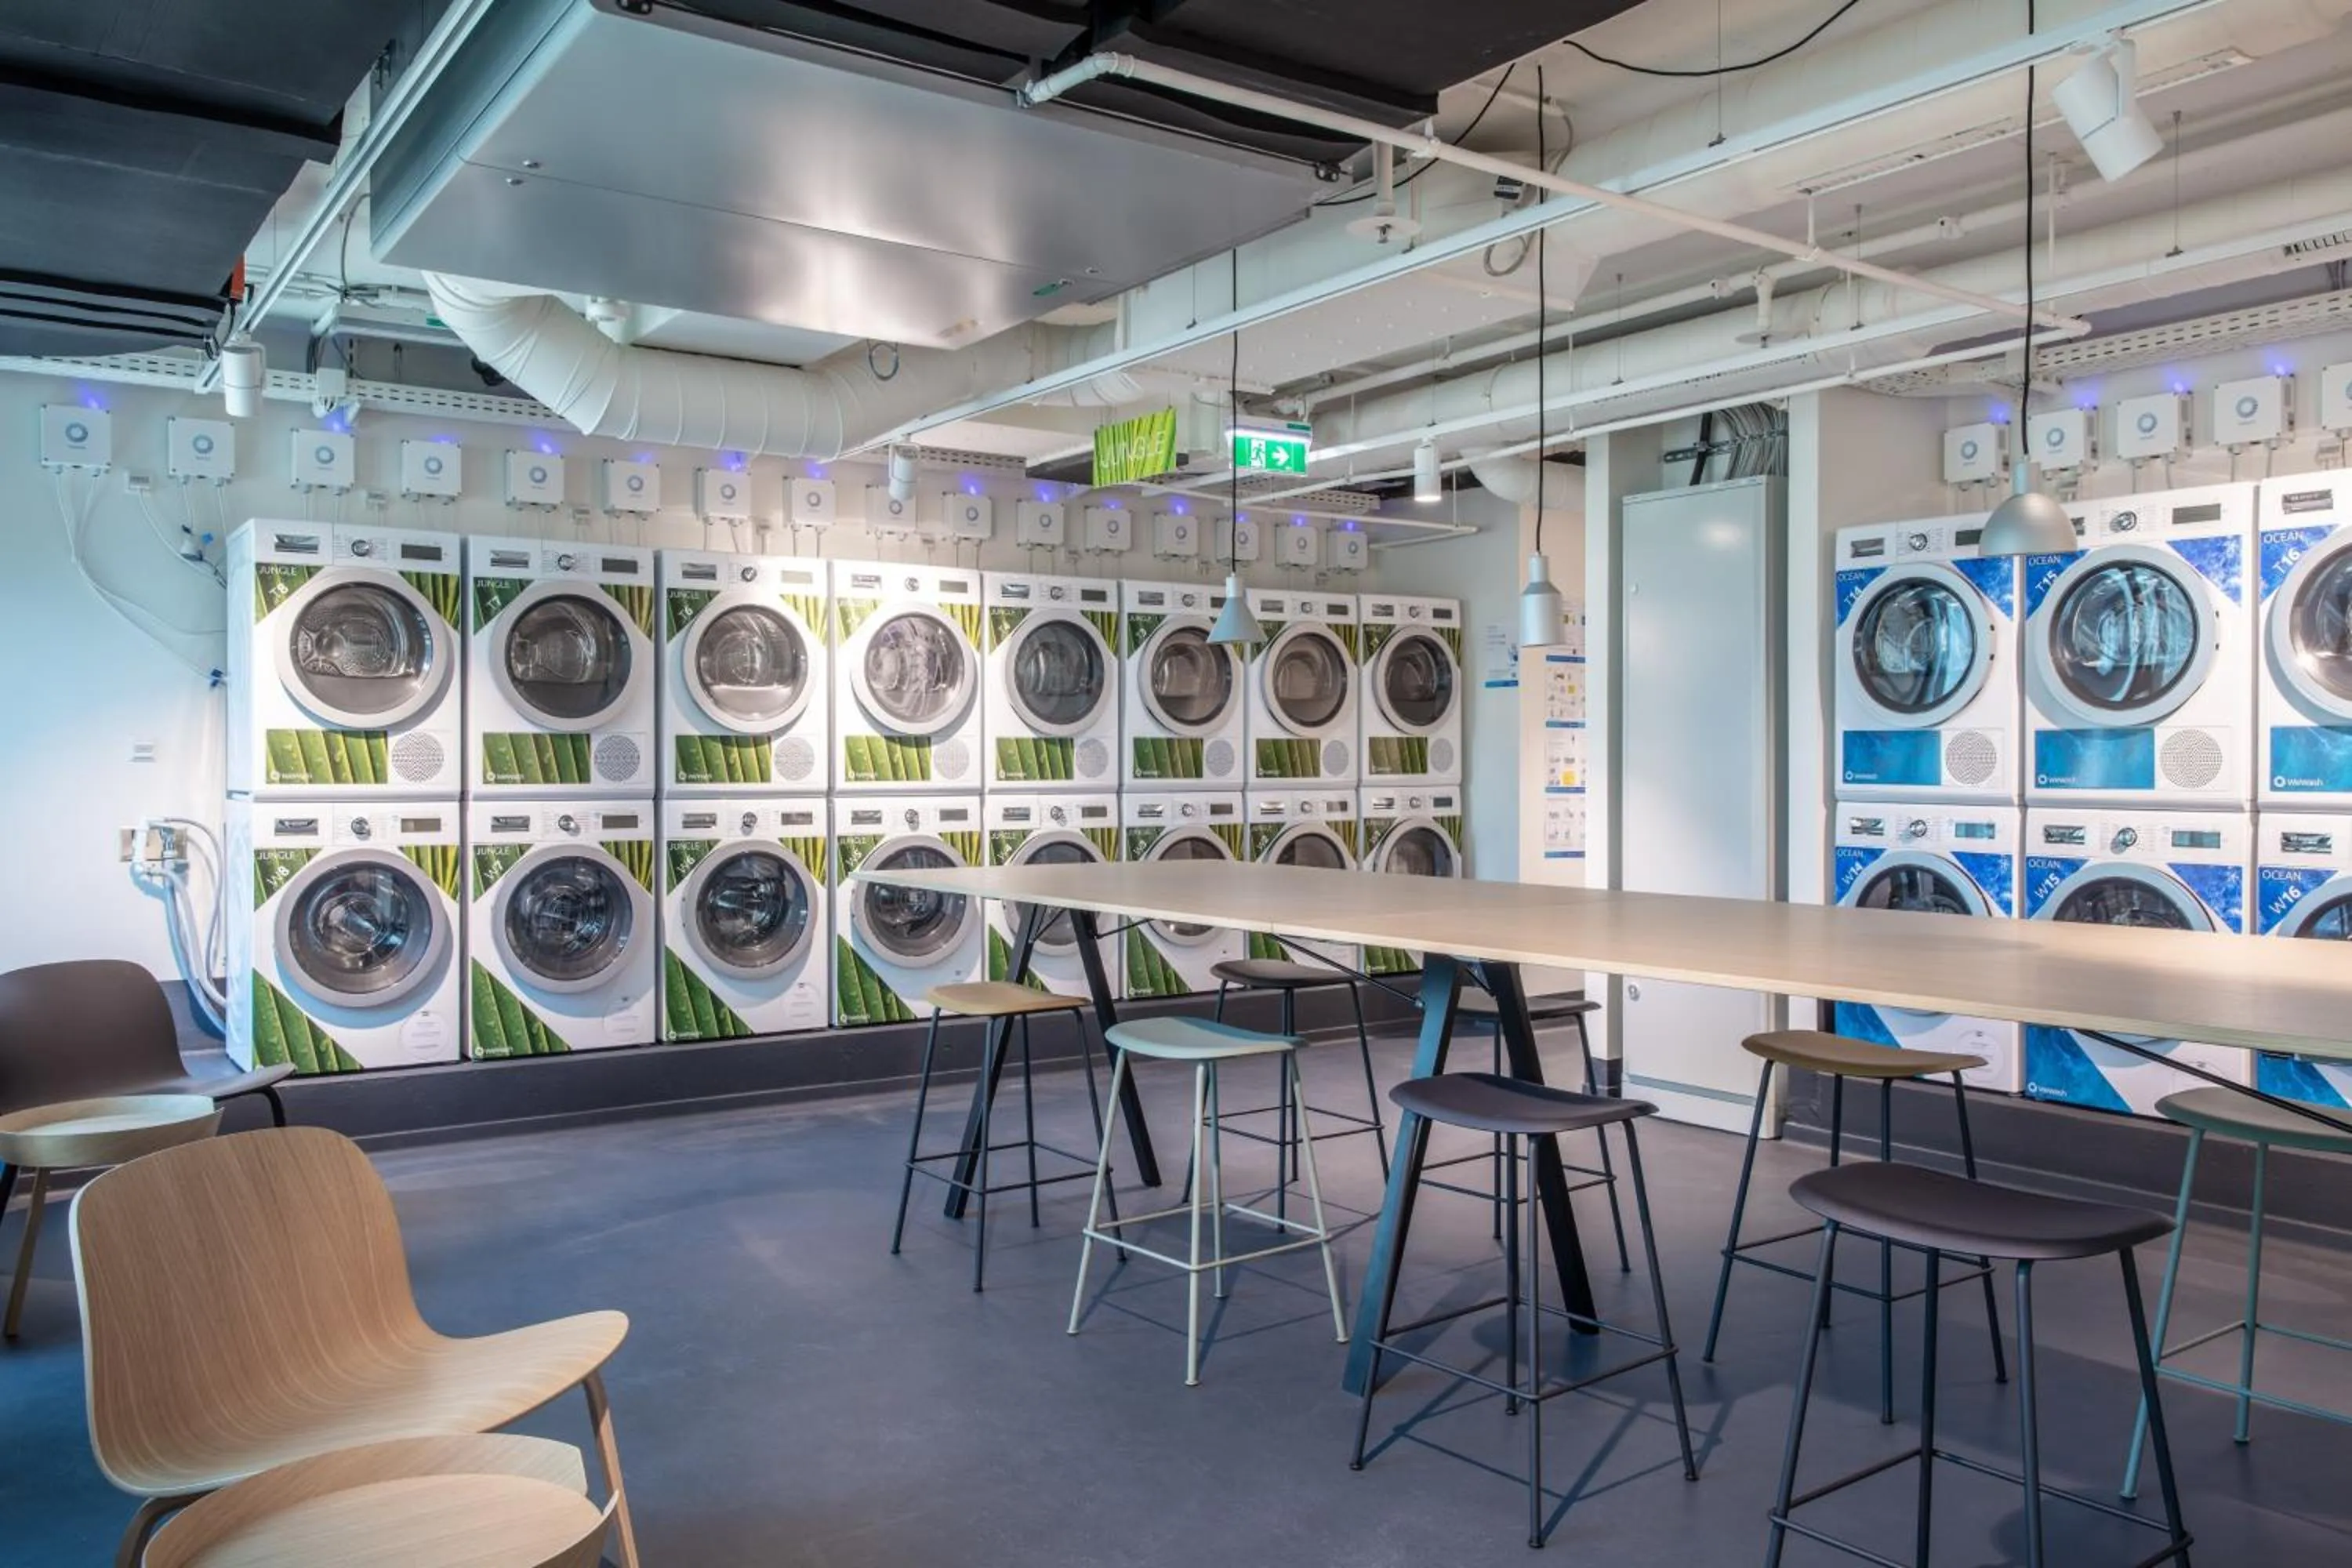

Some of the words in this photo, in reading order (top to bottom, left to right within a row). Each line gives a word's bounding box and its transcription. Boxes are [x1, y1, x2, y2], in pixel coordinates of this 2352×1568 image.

[1100, 430, 1166, 468] JUNGLE
[2263, 531, 2303, 544] OCEAN
[2028, 554, 2061, 566] OCEAN
[2272, 547, 2301, 574] T16
[258, 565, 297, 576] JUNGLE
[1837, 572, 1866, 582] OCEAN
[2034, 570, 2058, 593] T15
[268, 583, 289, 598] T8
[256, 851, 295, 860] JUNGLE
[1837, 849, 1864, 858] OCEAN
[2027, 858, 2061, 869] OCEAN
[267, 865, 289, 887] W8
[2262, 869, 2302, 880] OCEAN
[2034, 873, 2060, 899] W15
[2268, 885, 2302, 914] W16
